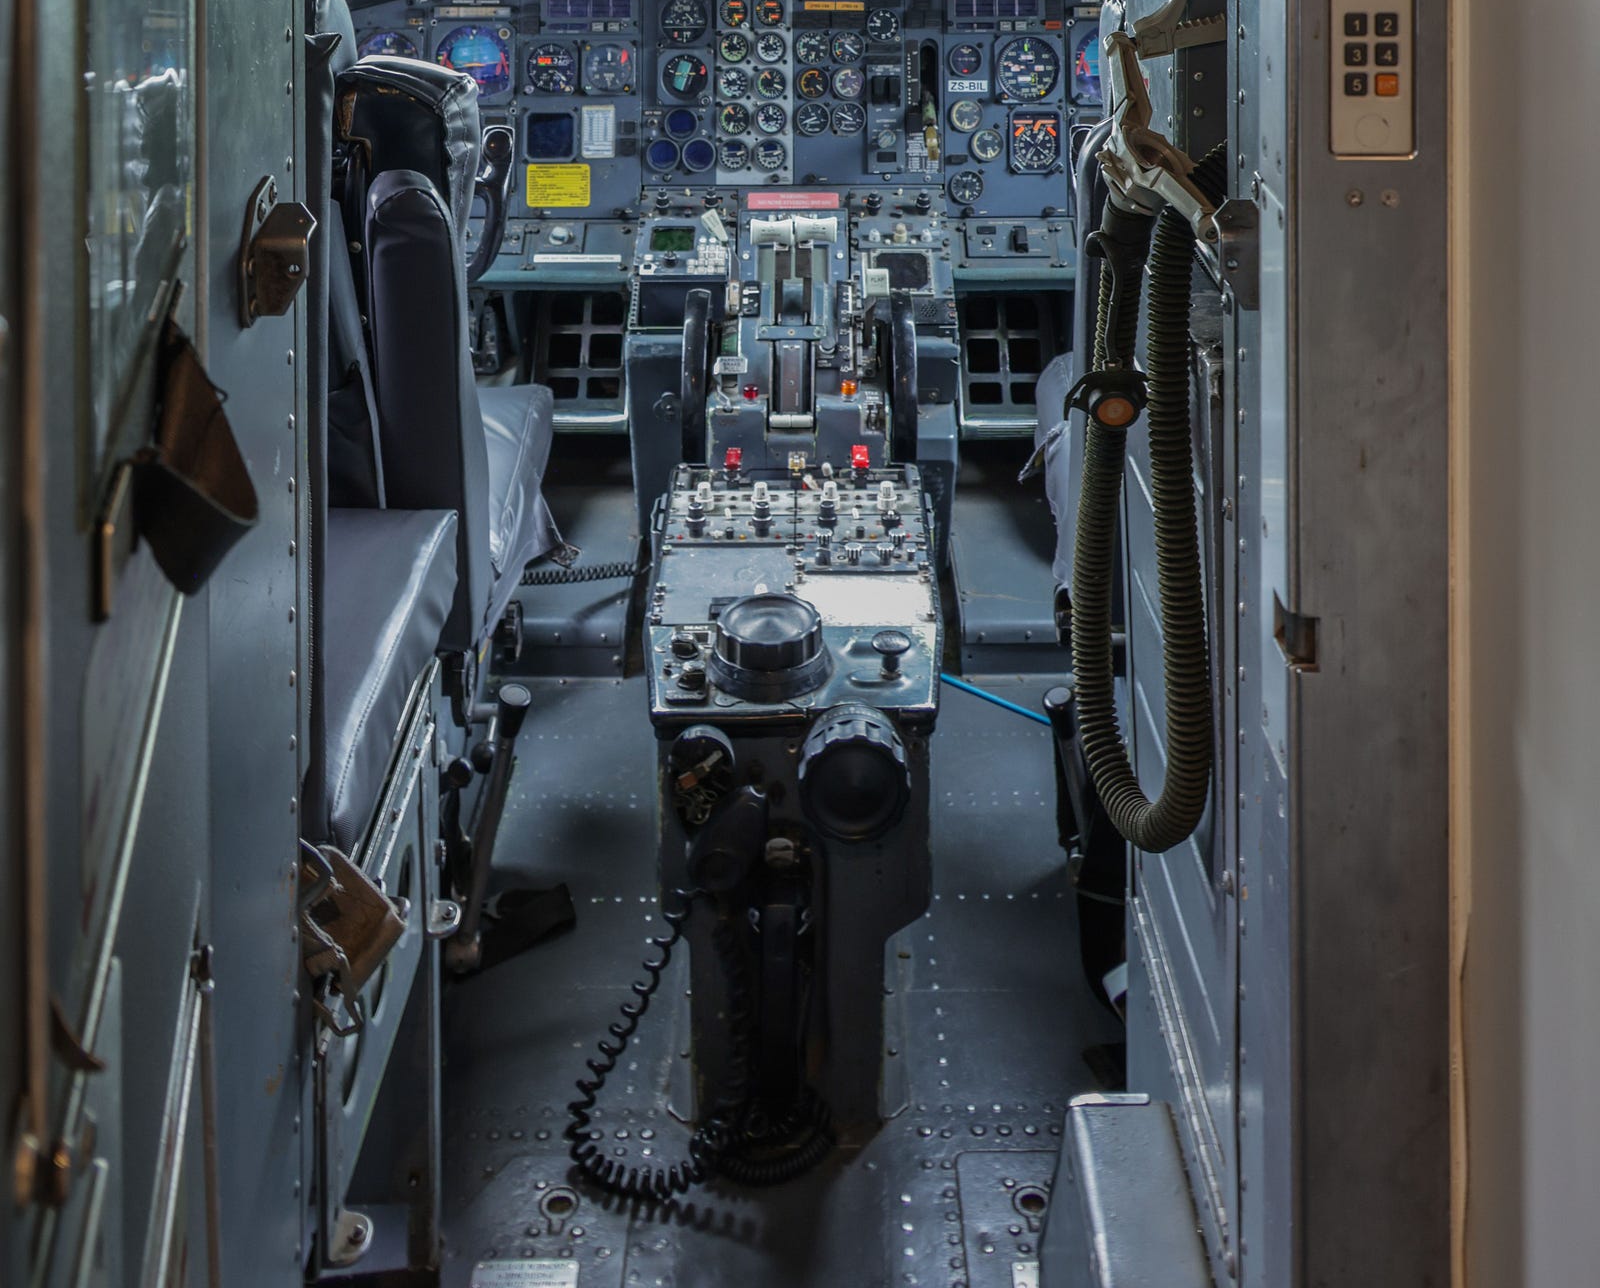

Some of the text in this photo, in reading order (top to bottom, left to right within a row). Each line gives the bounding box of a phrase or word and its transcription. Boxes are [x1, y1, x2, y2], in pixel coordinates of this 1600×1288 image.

[1353, 19, 1360, 32] 1
[1383, 18, 1392, 32] 2
[1352, 49, 1361, 62] 3
[1383, 49, 1393, 62] 4
[949, 82, 986, 91] ZS-BIL
[1352, 78, 1362, 92] 5
